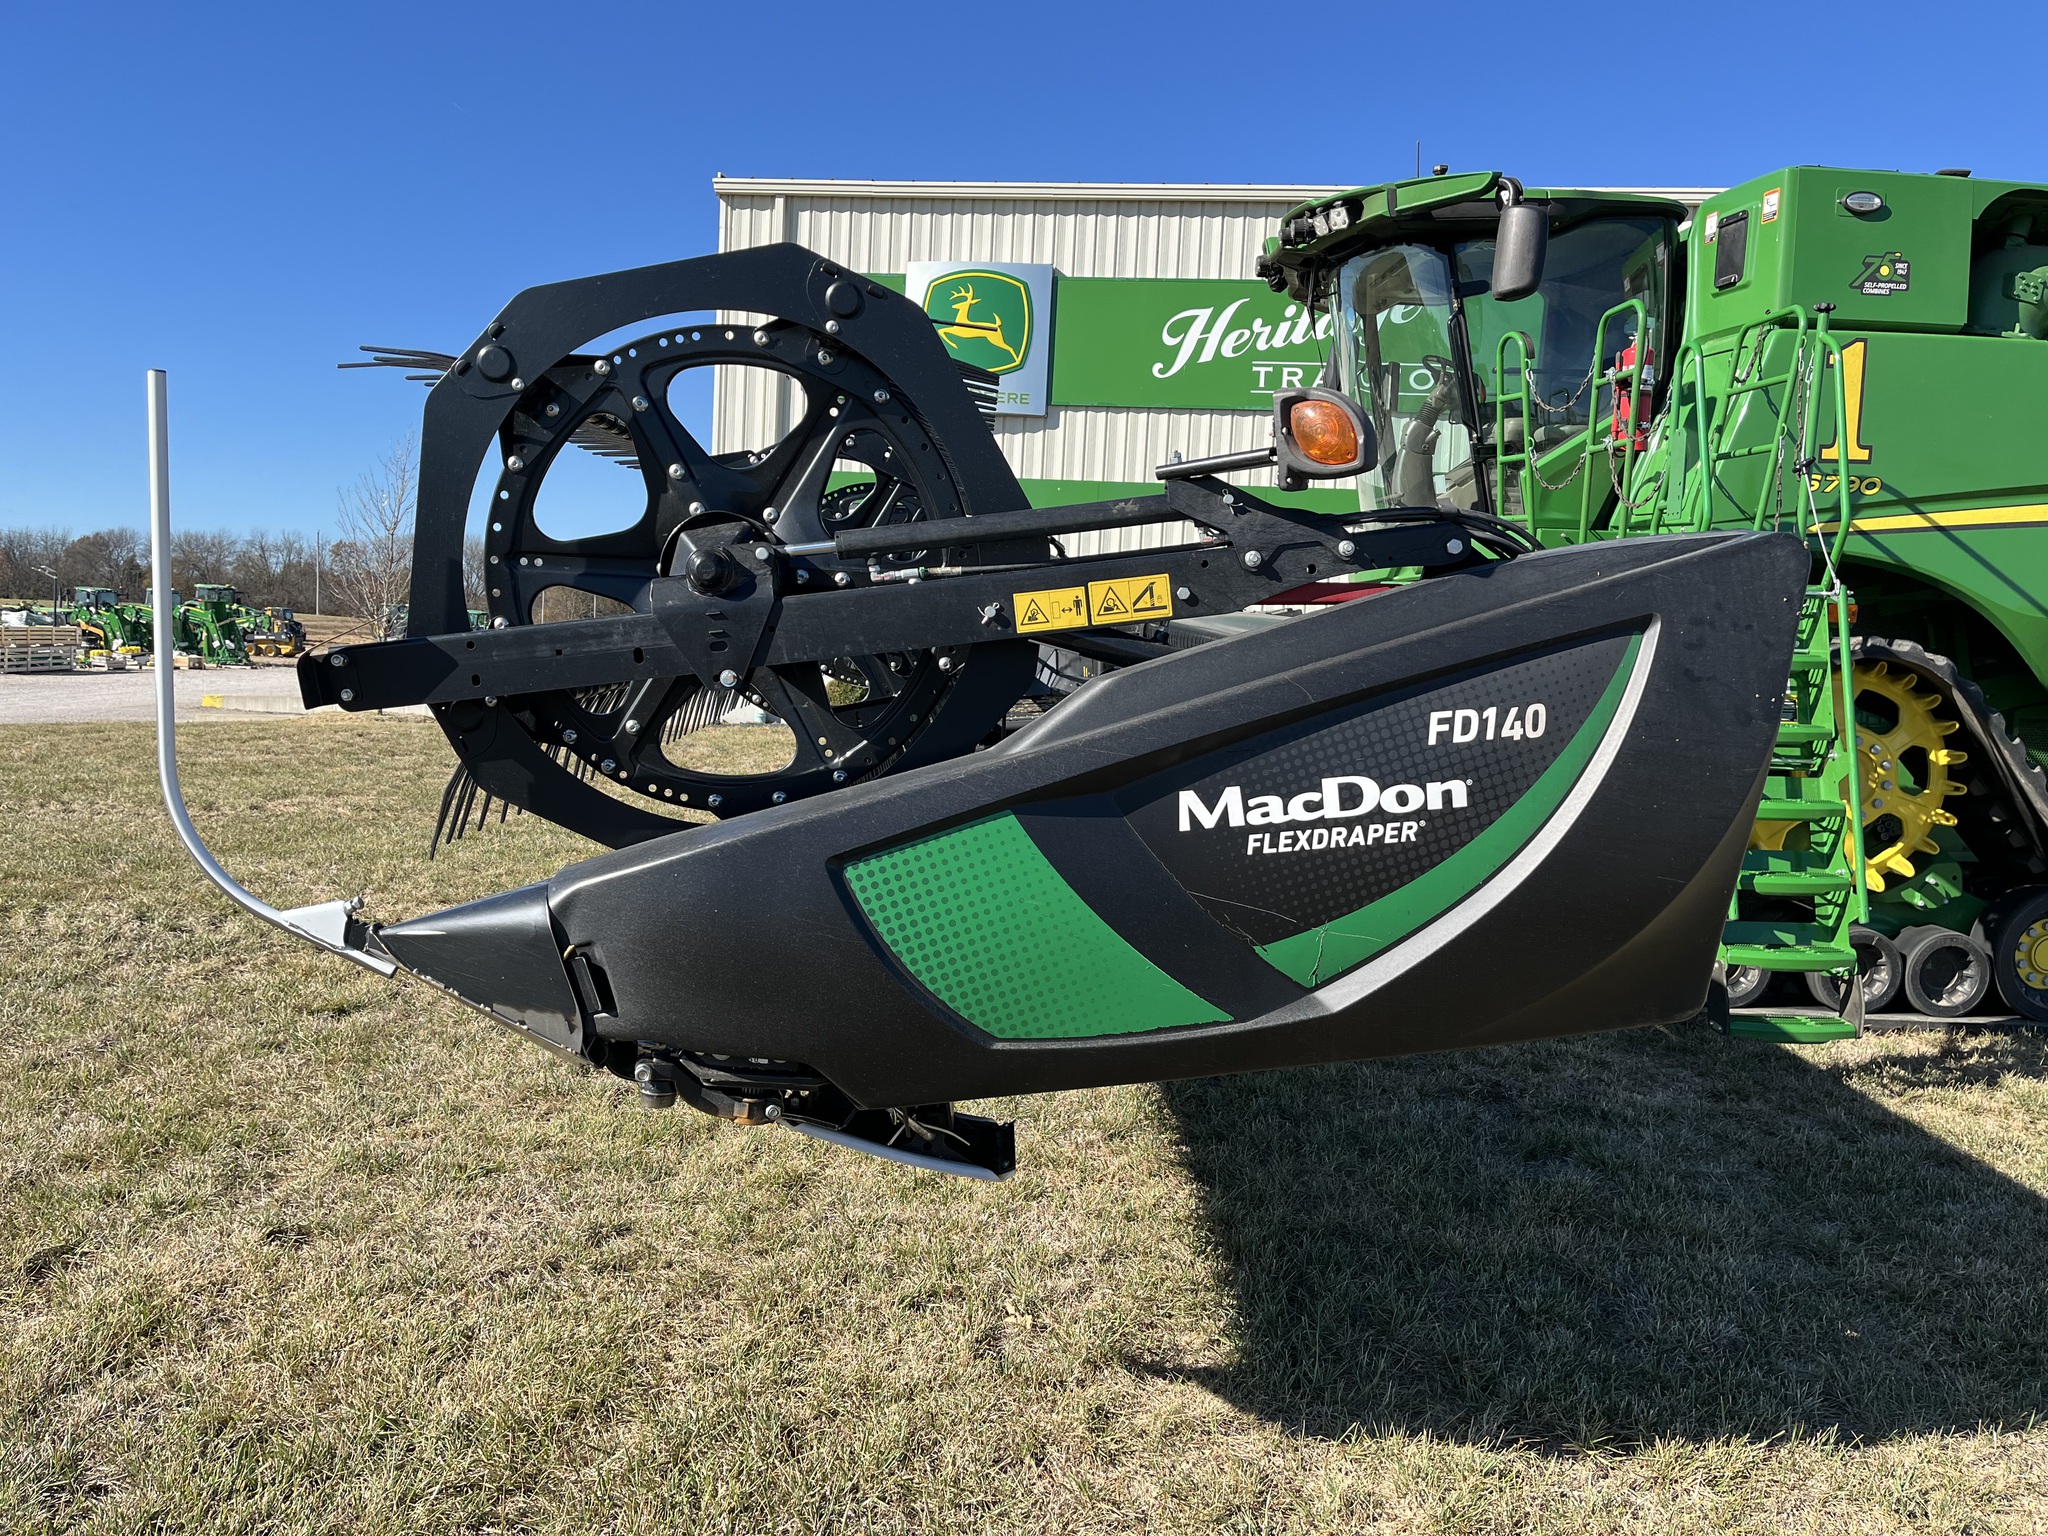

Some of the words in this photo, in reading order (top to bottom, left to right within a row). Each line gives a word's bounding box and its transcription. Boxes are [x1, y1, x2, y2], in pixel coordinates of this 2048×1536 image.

[1851, 253, 1902, 287] 75
[1863, 282, 1907, 290] SELF-PROPELLED
[1151, 298, 1424, 379] Heritae
[1427, 703, 1547, 746] FD140
